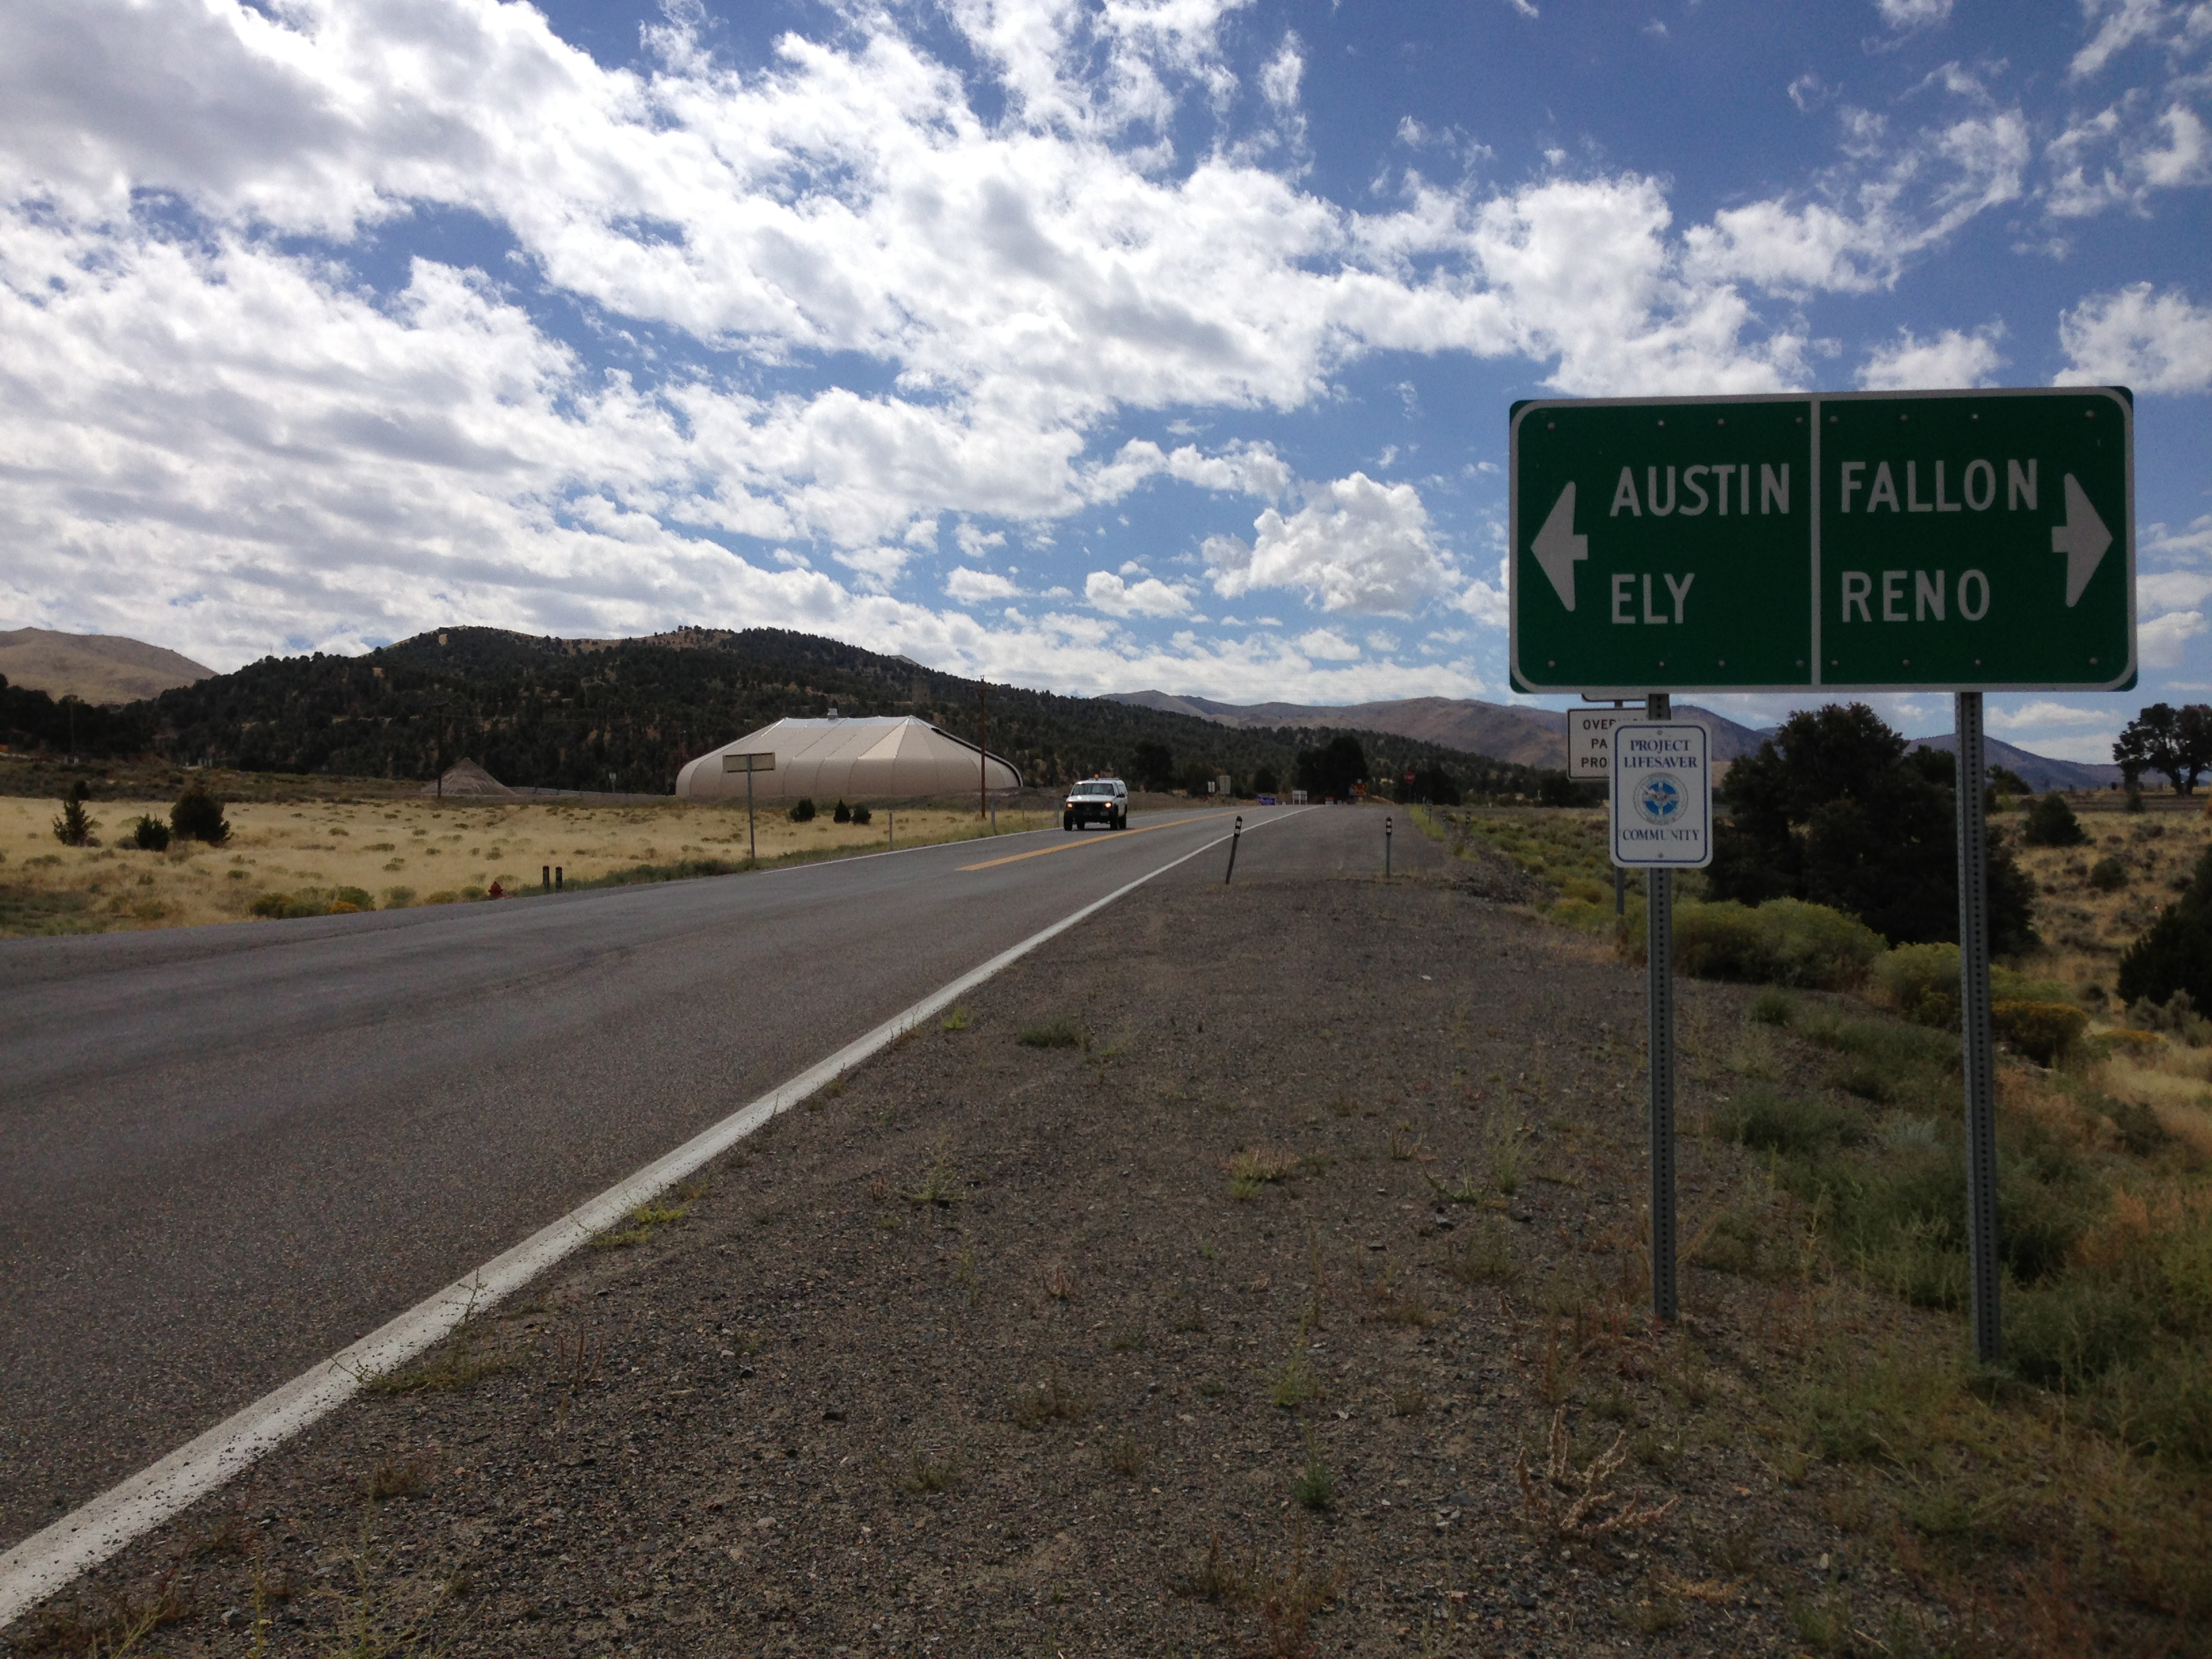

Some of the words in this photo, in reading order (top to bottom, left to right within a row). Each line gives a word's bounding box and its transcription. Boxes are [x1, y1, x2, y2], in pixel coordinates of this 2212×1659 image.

[1610, 463, 1790, 517] AUSTIN
[1841, 459, 2038, 513] FALLON
[1612, 573, 1695, 624] ELY
[1842, 569, 1990, 622] RENO
[1581, 757, 1607, 768] PRO
[1624, 756, 1698, 768] LIFESAVER
[1630, 739, 1691, 754] PROJECT
[1622, 829, 1700, 841] COMMUNITY
